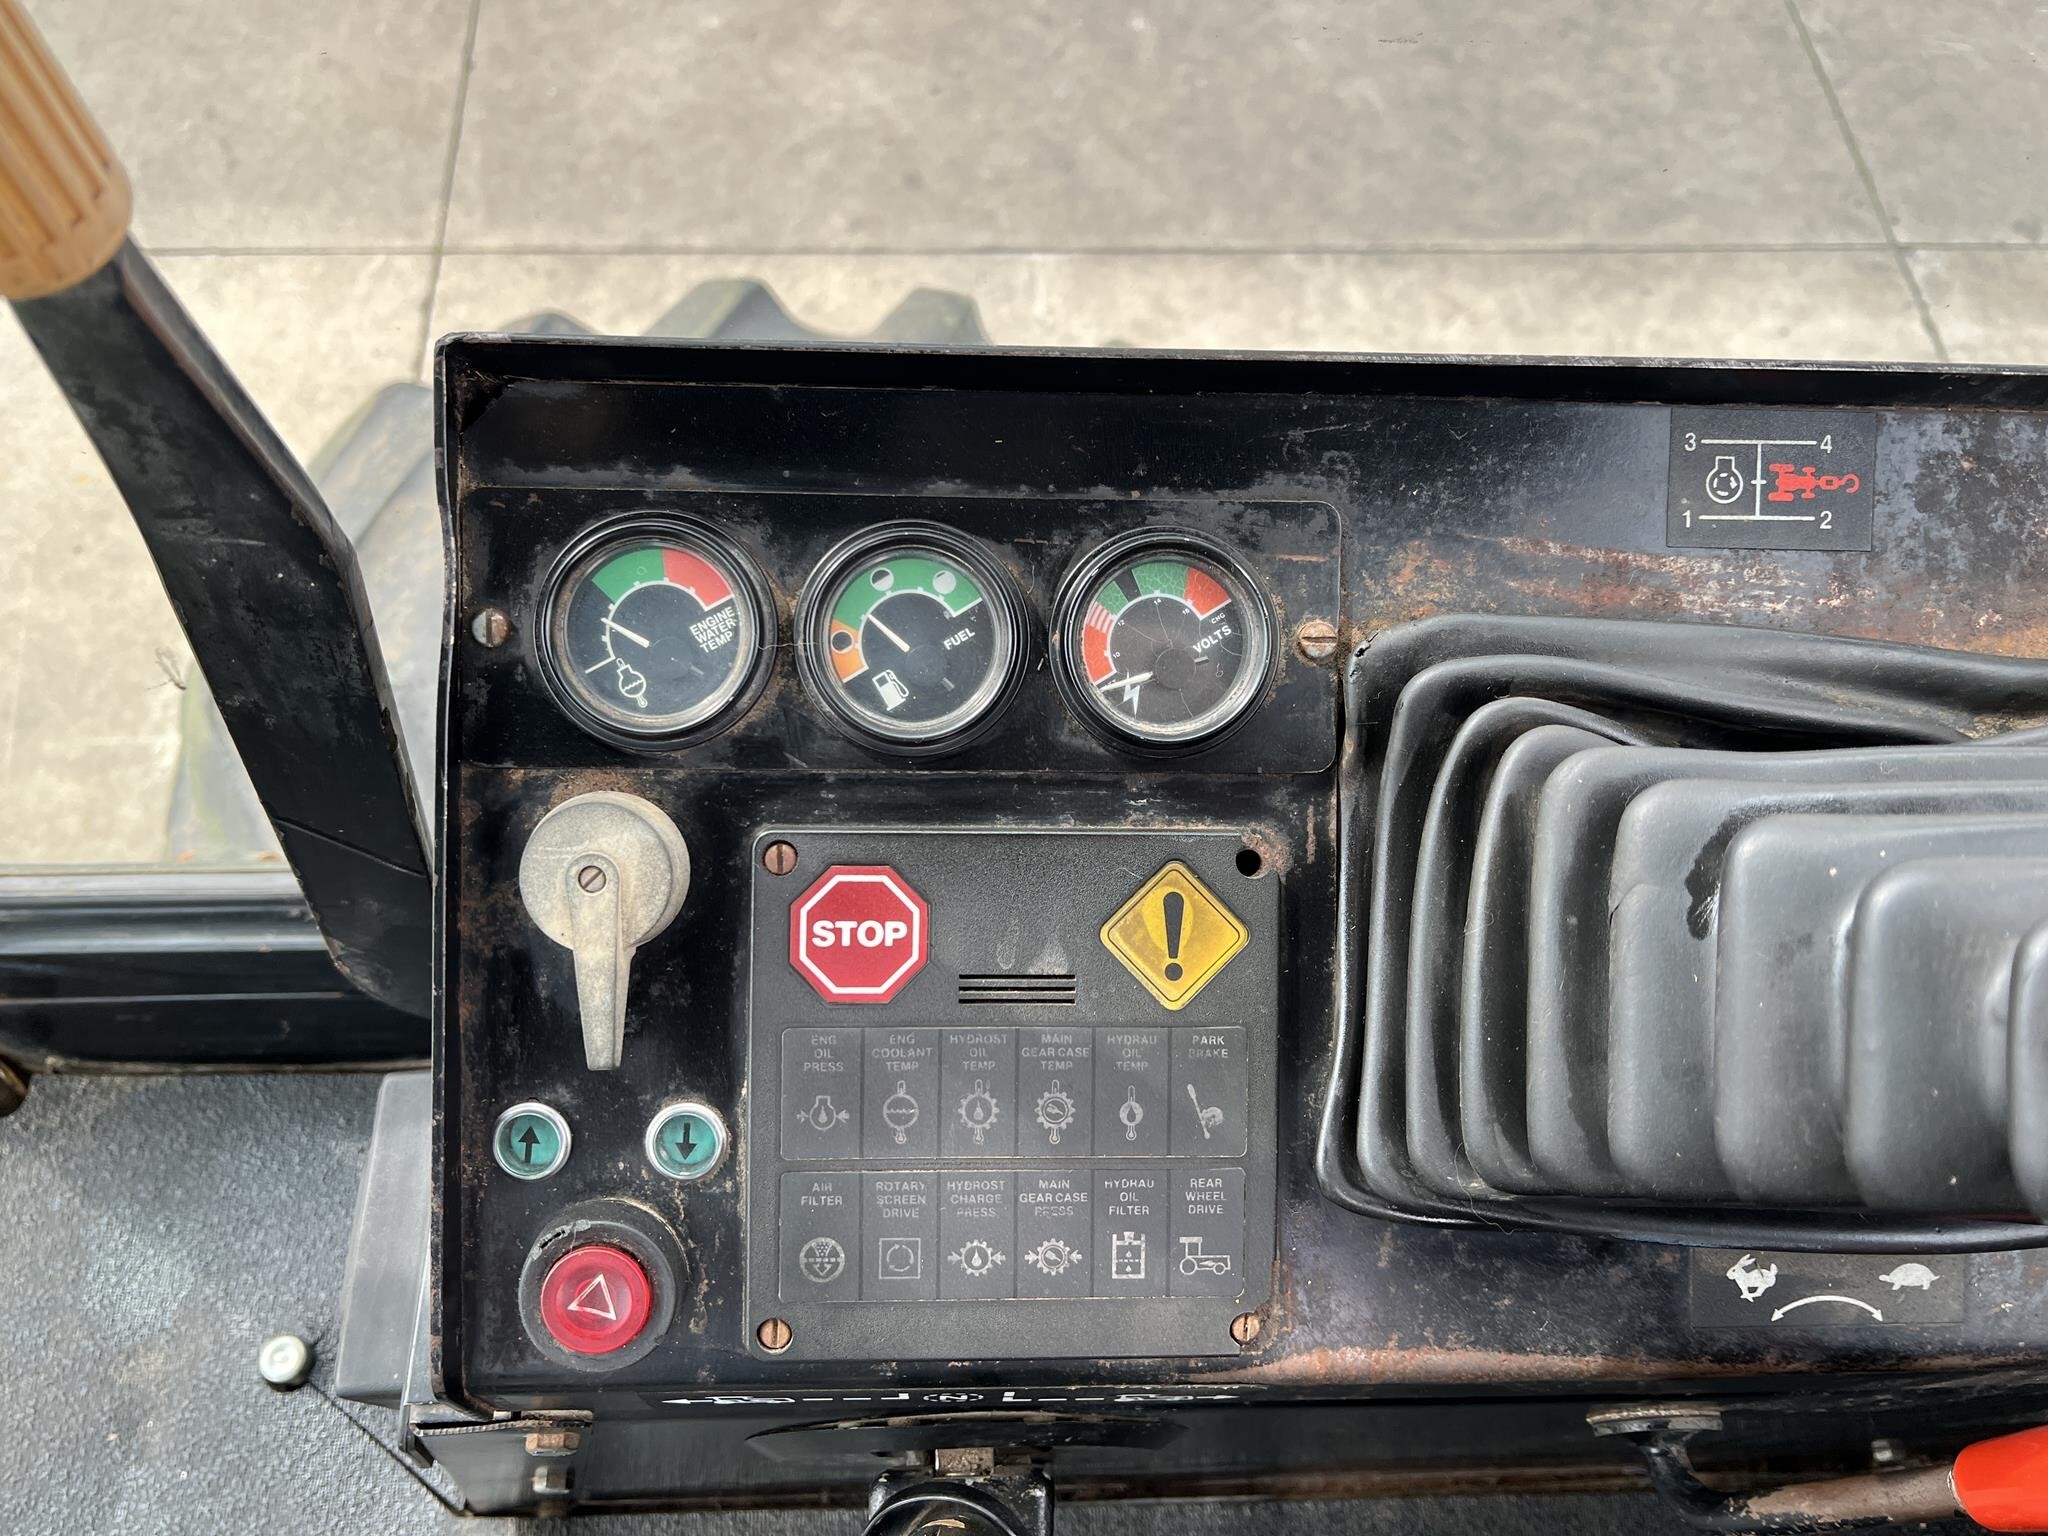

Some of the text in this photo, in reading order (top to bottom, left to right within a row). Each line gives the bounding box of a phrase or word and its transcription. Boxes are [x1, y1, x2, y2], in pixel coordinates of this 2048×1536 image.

[1684, 432, 1697, 451] 3
[1820, 434, 1833, 453] 4
[1682, 509, 1691, 528] 1
[1819, 510, 1832, 529] 2
[689, 606, 735, 636] ENGINE
[694, 617, 737, 644] WATER
[699, 631, 733, 653] TEMP
[944, 628, 976, 650] FUEL
[1193, 625, 1231, 653] VOLTS
[811, 920, 908, 948] STOP
[811, 1035, 837, 1045] ENG
[889, 1035, 915, 1045] ENG
[950, 1034, 1008, 1045] HYDROST
[1041, 1034, 1072, 1045] MAIN
[1107, 1035, 1157, 1045] HYDRAU
[1192, 1035, 1225, 1045] PARK
[814, 1048, 833, 1059] OIL
[872, 1048, 933, 1058] COOLANT
[969, 1047, 988, 1058] OIL
[1122, 1048, 1141, 1058] OIL
[803, 1062, 844, 1072] PRESS
[886, 1061, 919, 1072] TEMP
[963, 1061, 996, 1071] TEMP
[1041, 1061, 1073, 1071] TEMP
[1116, 1061, 1149, 1071] TEMP
[812, 1182, 833, 1192] AIR
[875, 1181, 926, 1192] ROTARY
[947, 1181, 1005, 1191] HYDROST
[1039, 1179, 1070, 1189] MAIN
[1105, 1179, 1155, 1189] HYDRAU
[1190, 1178, 1223, 1188] REAR
[800, 1195, 843, 1206] FILTER
[876, 1195, 926, 1205] SCREEN
[950, 1194, 1002, 1204] CHARGE
[1119, 1192, 1140, 1202] OIL
[1185, 1191, 1227, 1201] WHEEL
[883, 1208, 920, 1218] DRIVE
[957, 1207, 997, 1217] PRESS
[1034, 1206, 1074, 1217] PRESS
[1109, 1205, 1150, 1216] FILTER
[1188, 1204, 1223, 1214] DRIVE
